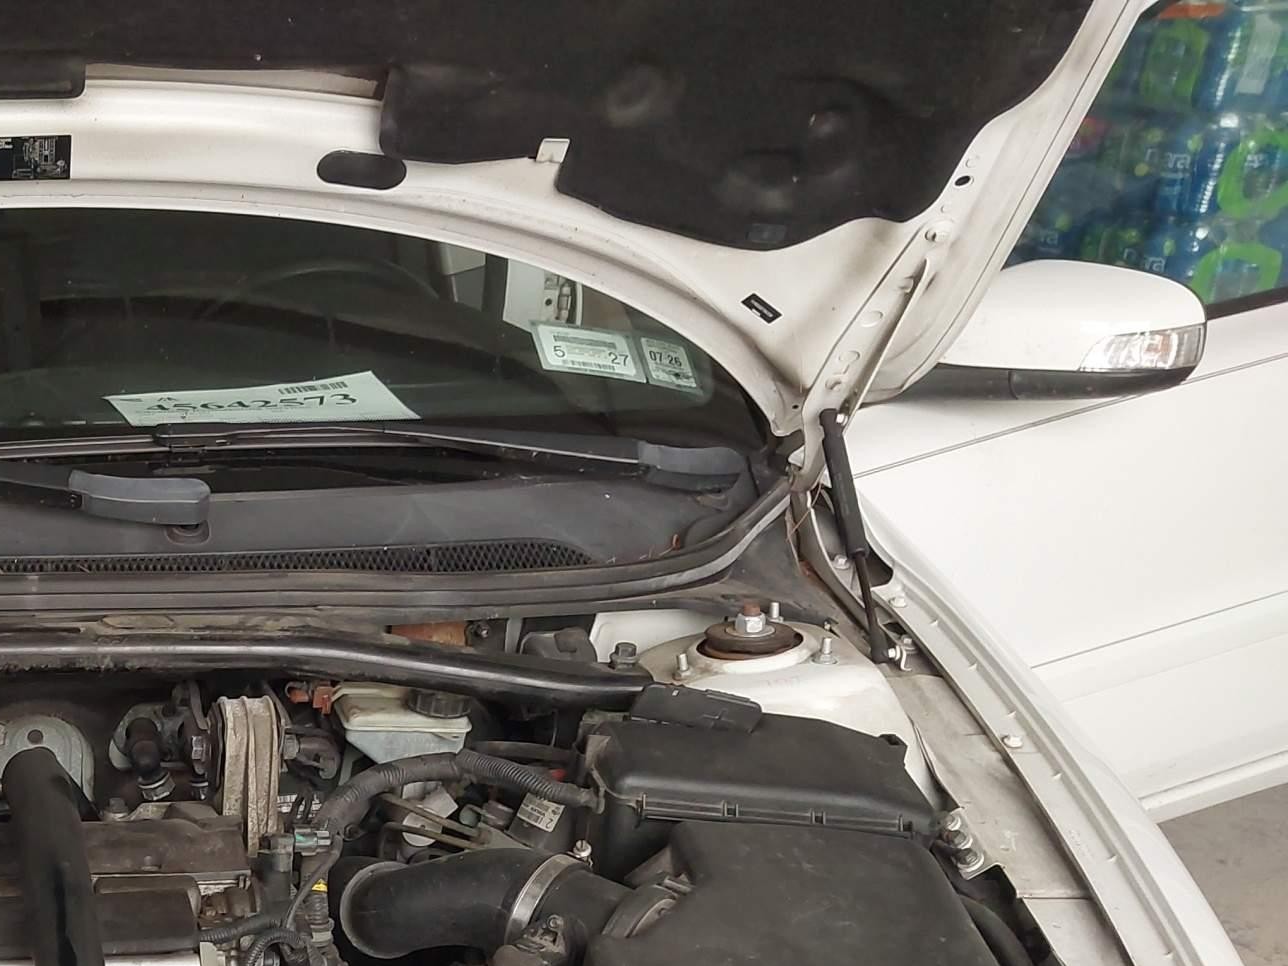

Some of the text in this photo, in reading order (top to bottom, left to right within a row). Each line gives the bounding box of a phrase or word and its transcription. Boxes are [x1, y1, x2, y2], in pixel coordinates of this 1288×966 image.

[553, 345, 566, 358] 5
[608, 352, 629, 367] 27
[648, 350, 663, 362] 07
[146, 391, 359, 412] 45642573
